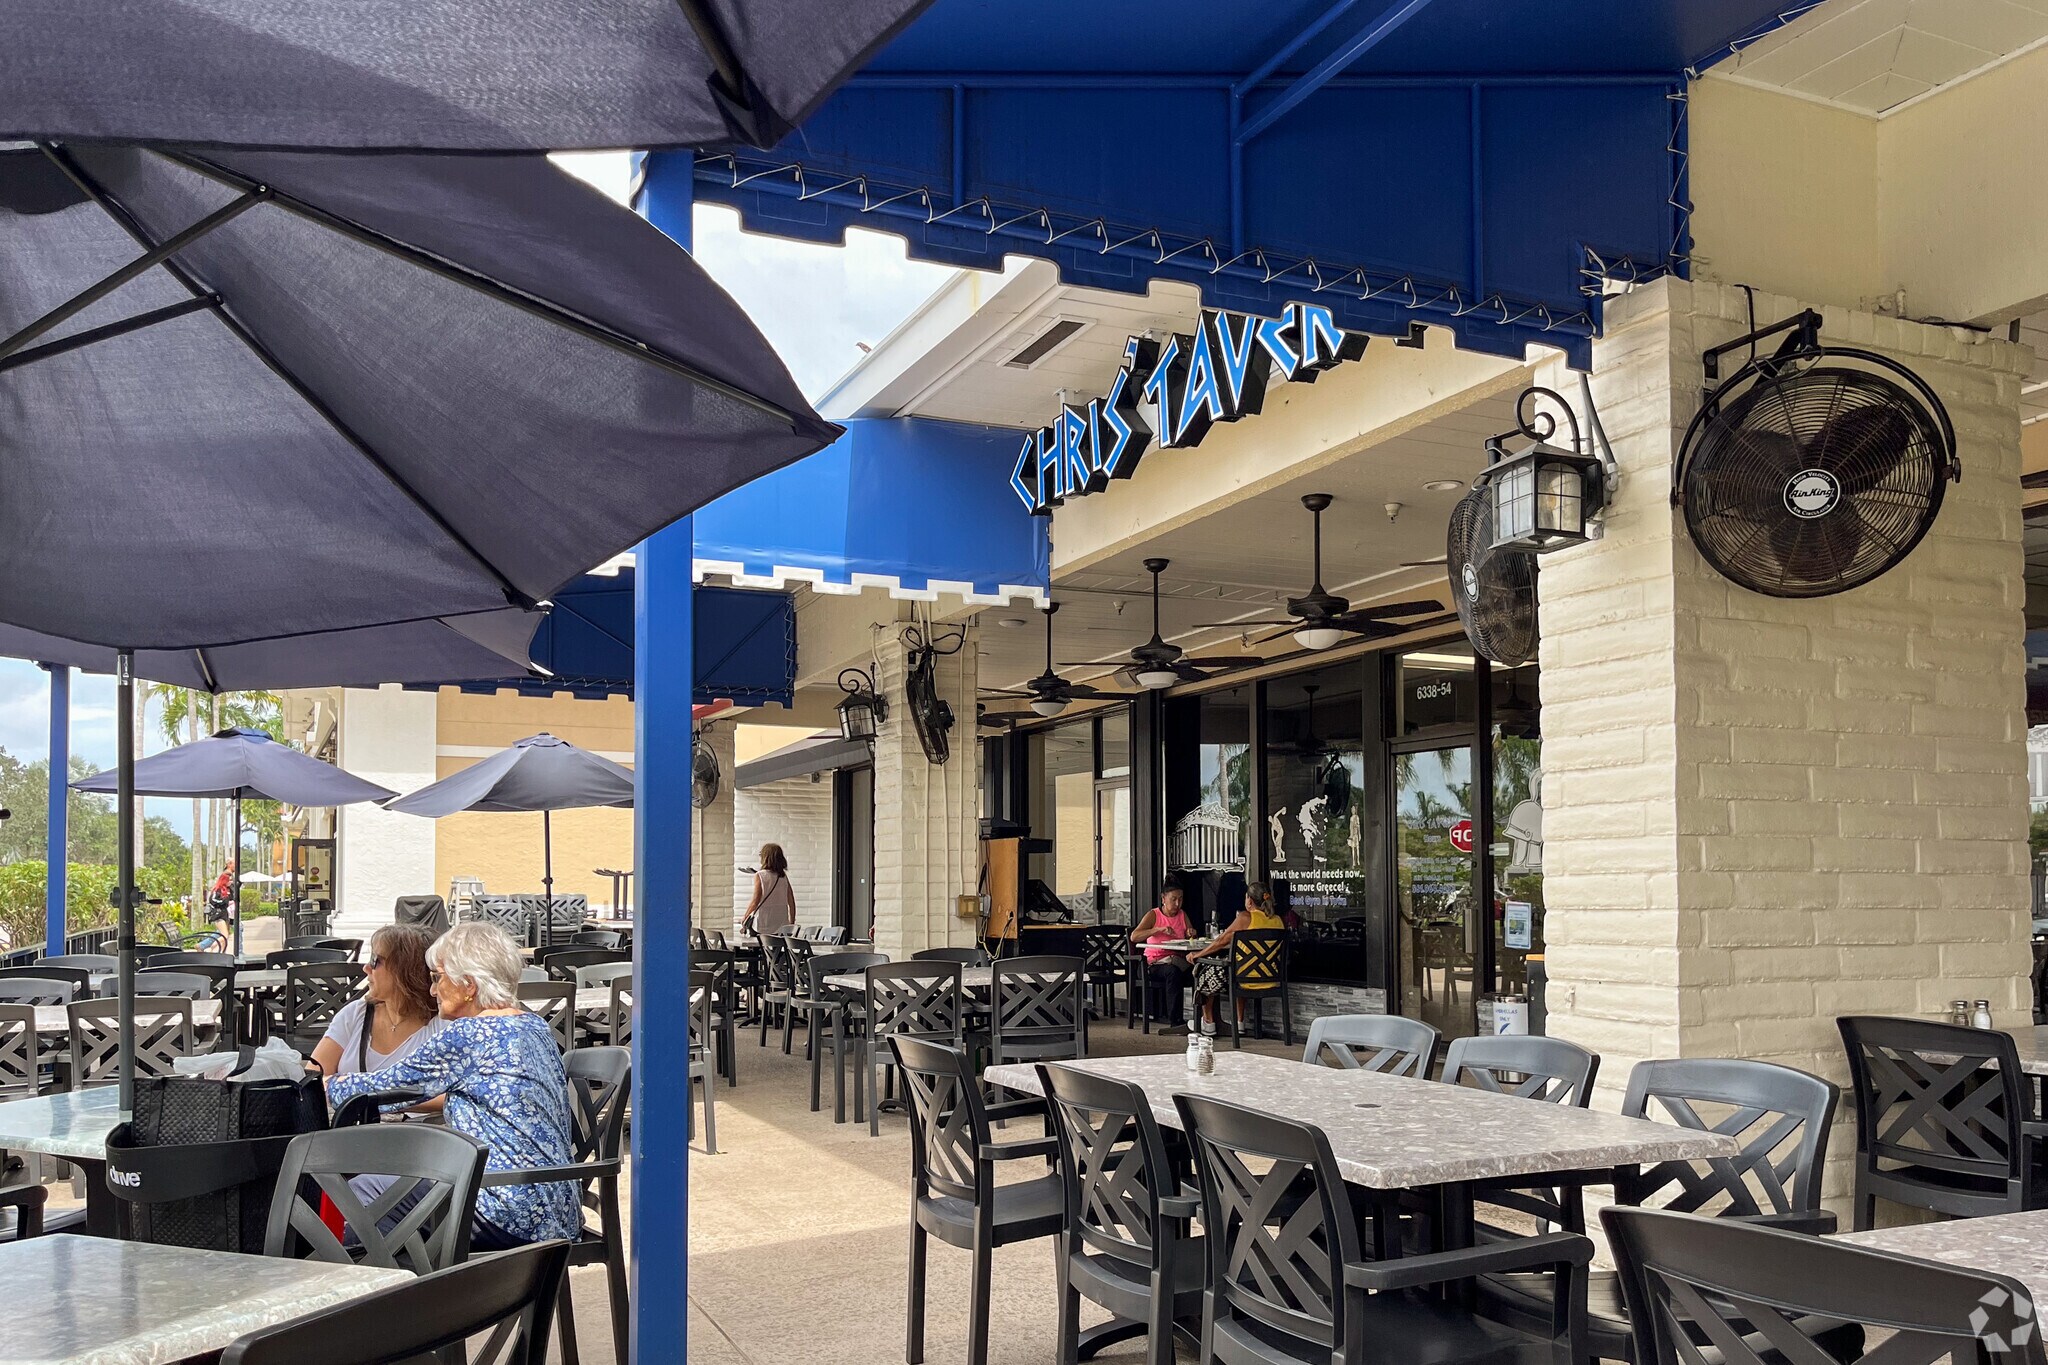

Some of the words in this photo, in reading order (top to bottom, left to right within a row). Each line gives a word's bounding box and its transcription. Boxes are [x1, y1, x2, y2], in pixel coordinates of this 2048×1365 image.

[1009, 338, 1140, 516] CHRIS'
[1416, 681, 1452, 700] 6338-54
[1270, 870, 1287, 879] What
[1288, 869, 1300, 879] the
[1300, 868, 1321, 879] world
[1321, 868, 1344, 879] needs
[1290, 882, 1297, 892] is
[1297, 883, 1315, 892] more
[1316, 881, 1345, 892] Greece!
[109, 1164, 141, 1188] drive
